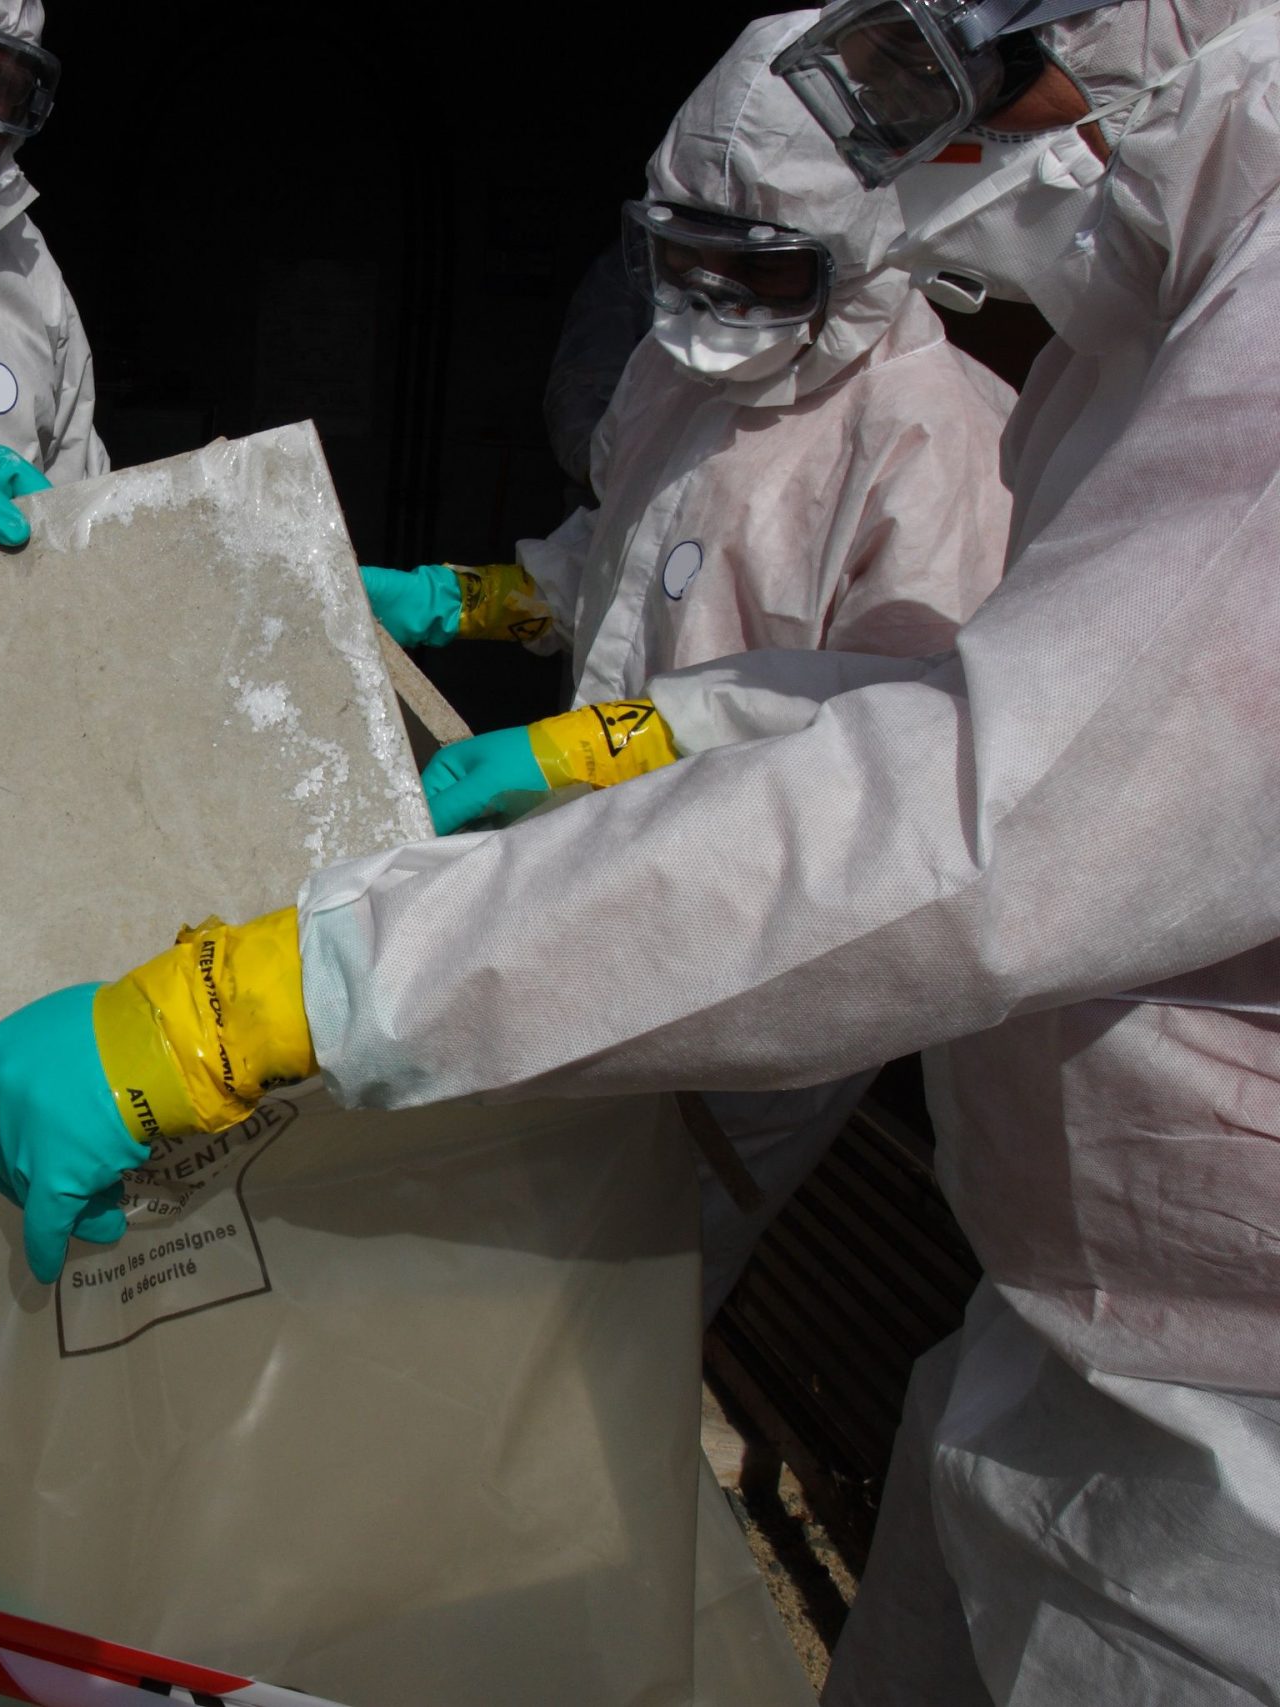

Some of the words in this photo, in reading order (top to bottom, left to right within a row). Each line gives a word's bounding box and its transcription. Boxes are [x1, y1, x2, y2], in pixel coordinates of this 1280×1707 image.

[240, 1104, 281, 1140] DE
[71, 1263, 126, 1289] Suivre
[128, 1253, 146, 1271] les
[149, 1224, 237, 1261] consignes
[120, 1286, 134, 1304] de
[137, 1258, 198, 1294] sécurité
